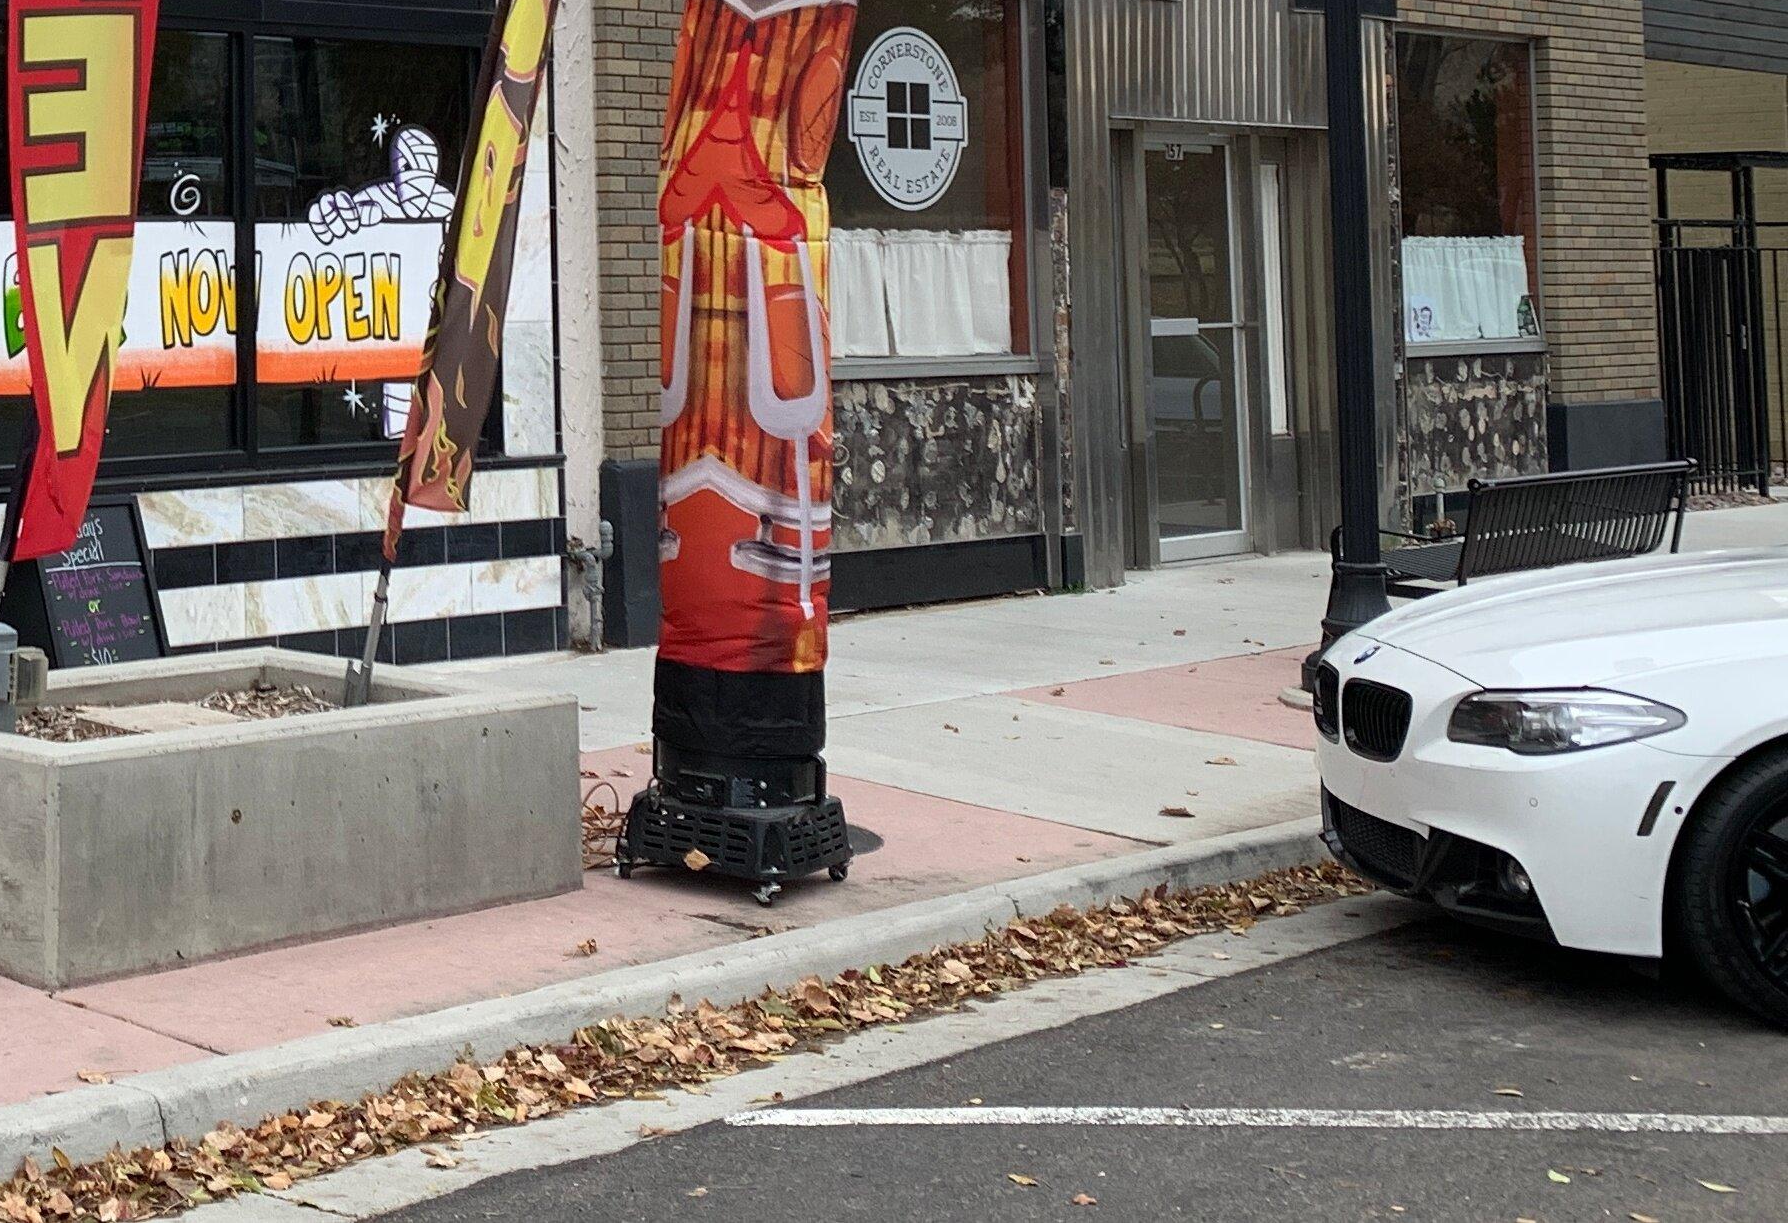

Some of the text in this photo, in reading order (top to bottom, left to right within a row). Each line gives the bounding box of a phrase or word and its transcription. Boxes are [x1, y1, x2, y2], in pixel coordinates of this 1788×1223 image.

[868, 42, 950, 94] CORNERSTONE
[859, 111, 880, 123] EST.
[869, 145, 951, 194] REAL ESTATE
[160, 247, 262, 348] NOW
[285, 251, 401, 345] OPEN
[88, 600, 101, 613] or
